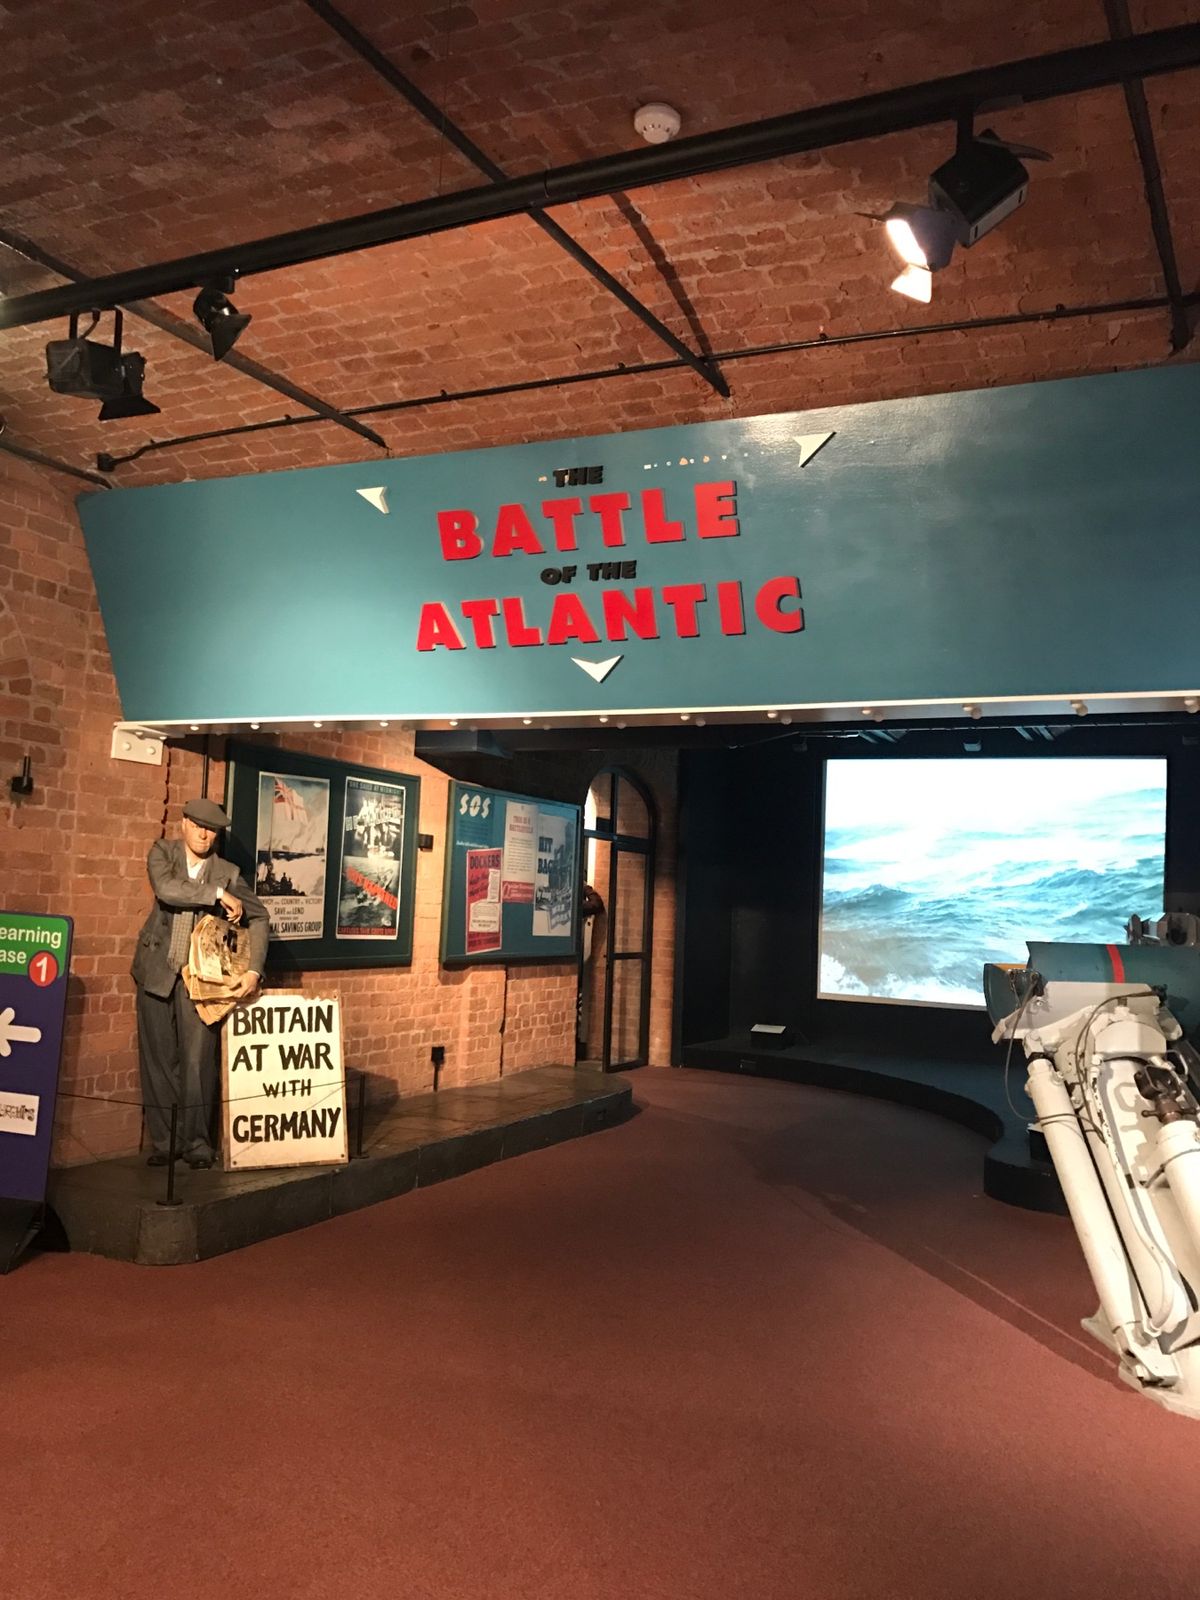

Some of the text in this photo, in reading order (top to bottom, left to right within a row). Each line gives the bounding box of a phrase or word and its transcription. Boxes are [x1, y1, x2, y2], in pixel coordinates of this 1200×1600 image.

[552, 465, 604, 488] THE
[437, 480, 740, 561] BATTLE
[540, 560, 637, 585] OF THE
[416, 576, 805, 651] ATLANTIC
[459, 793, 491, 819] SOS
[469, 854, 500, 870] DOCKERS
[274, 906, 286, 915] SAVE
[291, 906, 305, 915] LEND
[0, 926, 62, 949] earning
[280, 921, 304, 934] SAVINGS
[304, 920, 322, 933] GROUP
[0, 949, 48, 983] ase 1
[232, 1004, 334, 1037] BRITAIN
[231, 1042, 334, 1072] AT WAR
[262, 1078, 312, 1098] WITH
[232, 1106, 341, 1143] GERMANY
